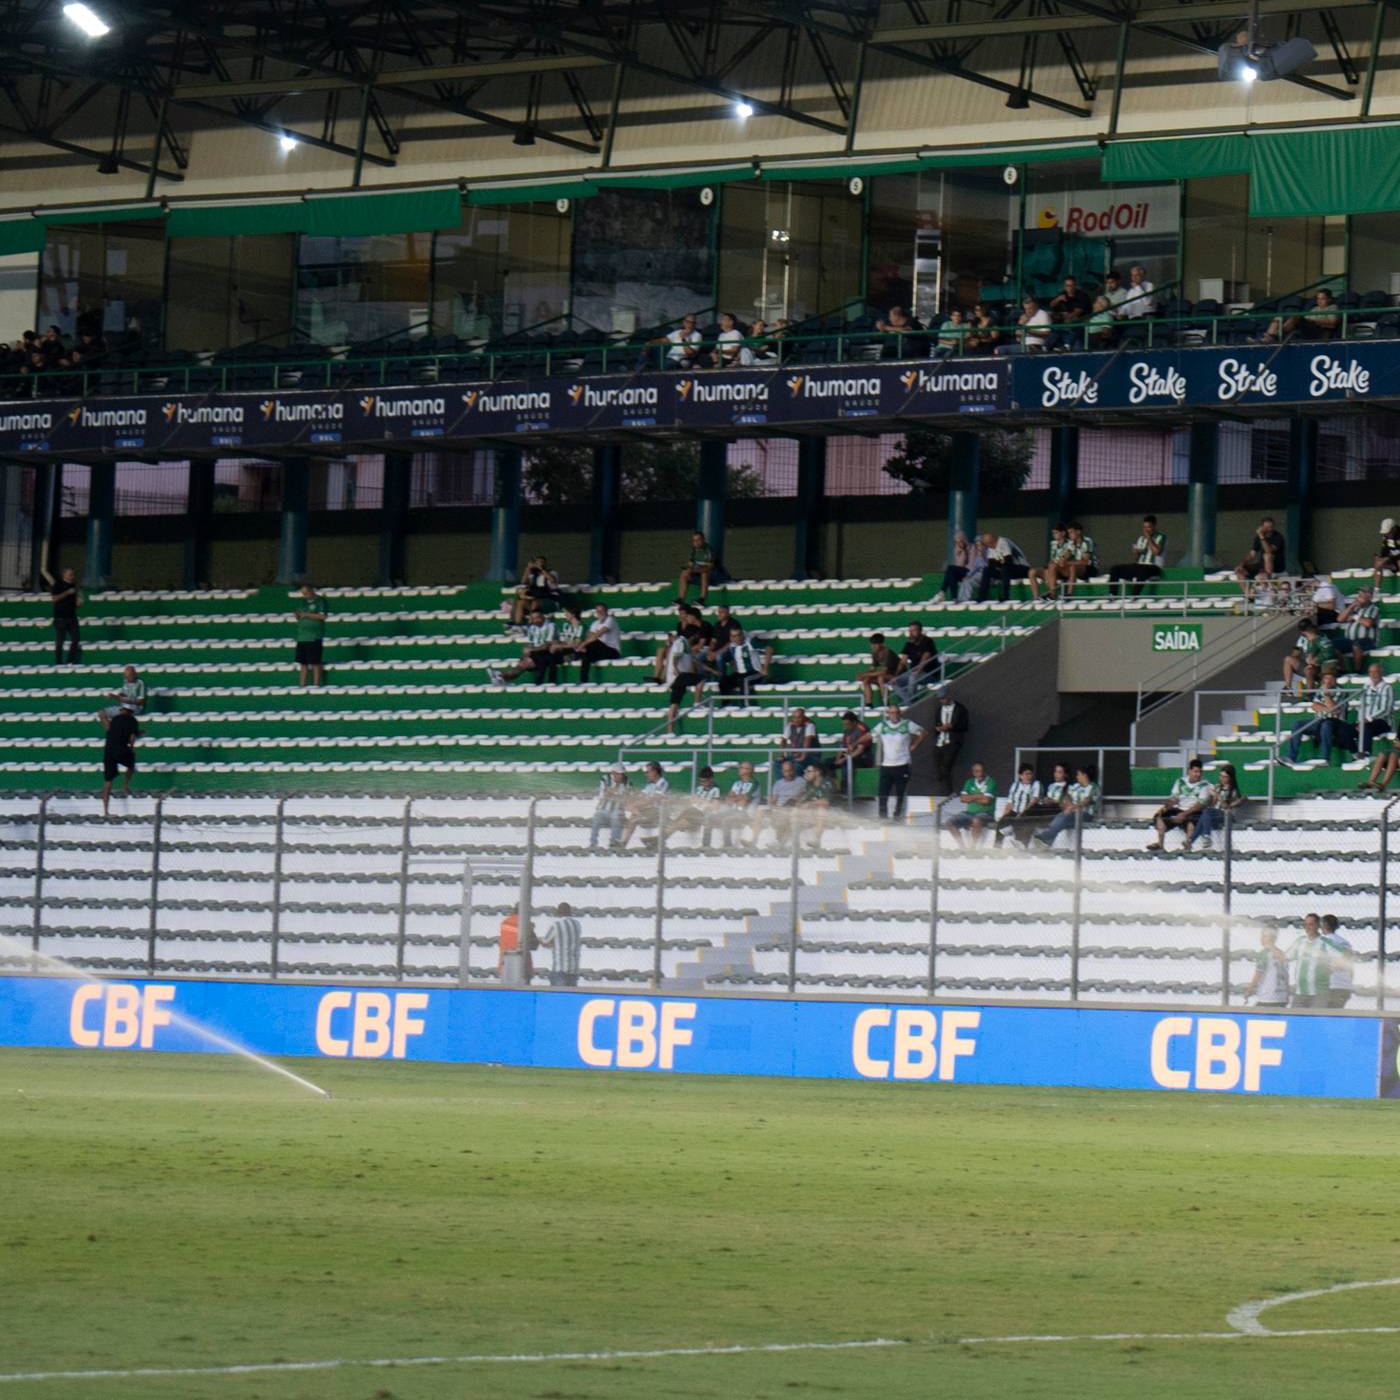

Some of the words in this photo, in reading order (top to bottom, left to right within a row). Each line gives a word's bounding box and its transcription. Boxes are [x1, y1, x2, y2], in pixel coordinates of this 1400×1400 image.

[1066, 203, 1149, 232] RodOil
[693, 379, 769, 401] humana
[804, 375, 881, 397] humana
[918, 369, 998, 392] humana
[1130, 363, 1186, 404] Stake
[1310, 354, 1369, 397] Stake
[82, 407, 147, 427] humana
[375, 396, 445, 417] humana
[0, 414, 52, 431] umana
[1155, 625, 1200, 650] SAÍDA
[70, 983, 176, 1049] CBF
[316, 991, 429, 1058] CBF
[577, 999, 697, 1069] CBF
[852, 1008, 981, 1080] CBF
[1151, 1017, 1287, 1091] CBF
